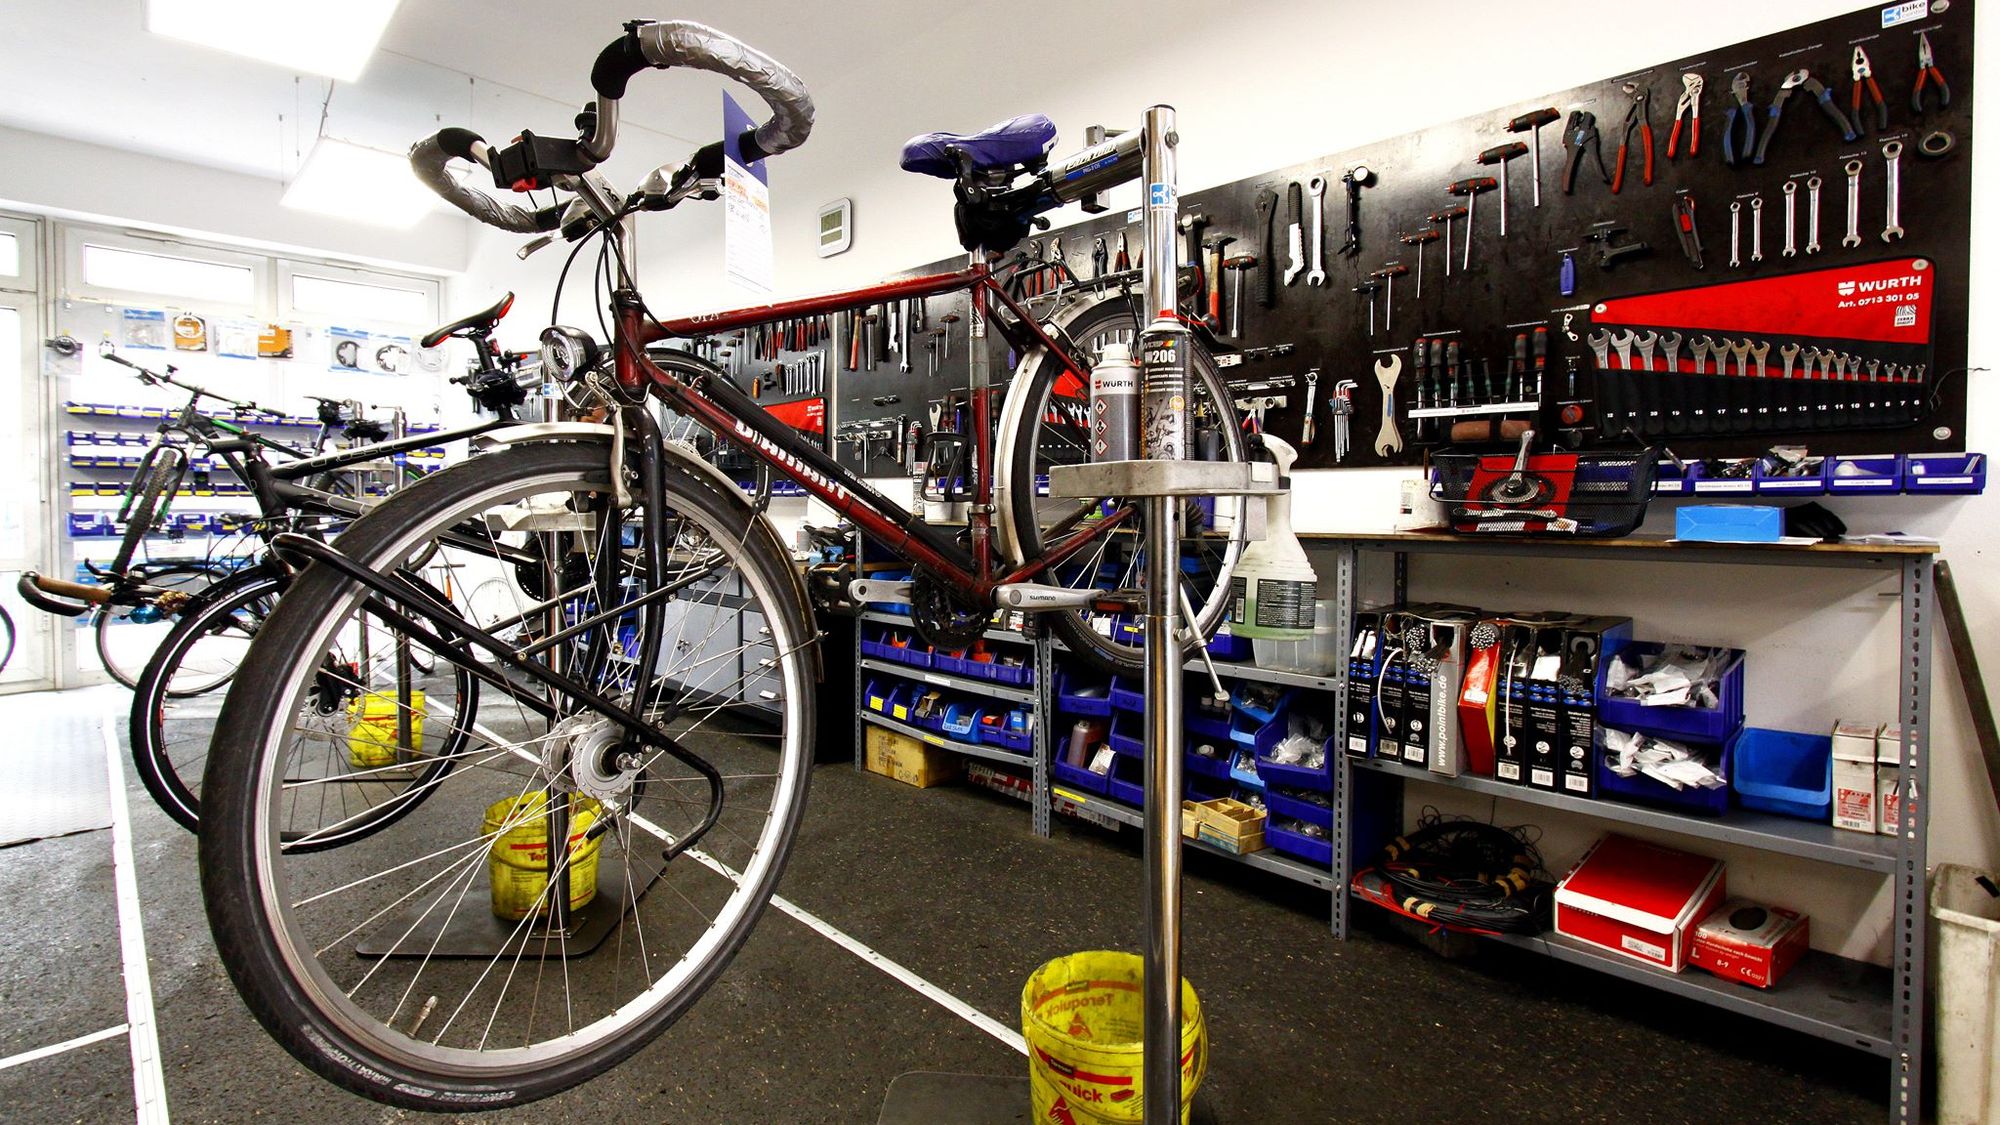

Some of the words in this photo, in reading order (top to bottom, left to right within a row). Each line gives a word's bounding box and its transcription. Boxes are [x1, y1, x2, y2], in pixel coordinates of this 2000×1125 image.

[1901, 2, 1926, 12] bike
[1858, 296, 1883, 306] 0713
[1885, 294, 1903, 302] 301
[1906, 292, 1919, 300] 05
[1152, 349, 1176, 363] 206
[1437, 675, 1448, 767] www.pointbike.de
[1691, 947, 1700, 959] L
